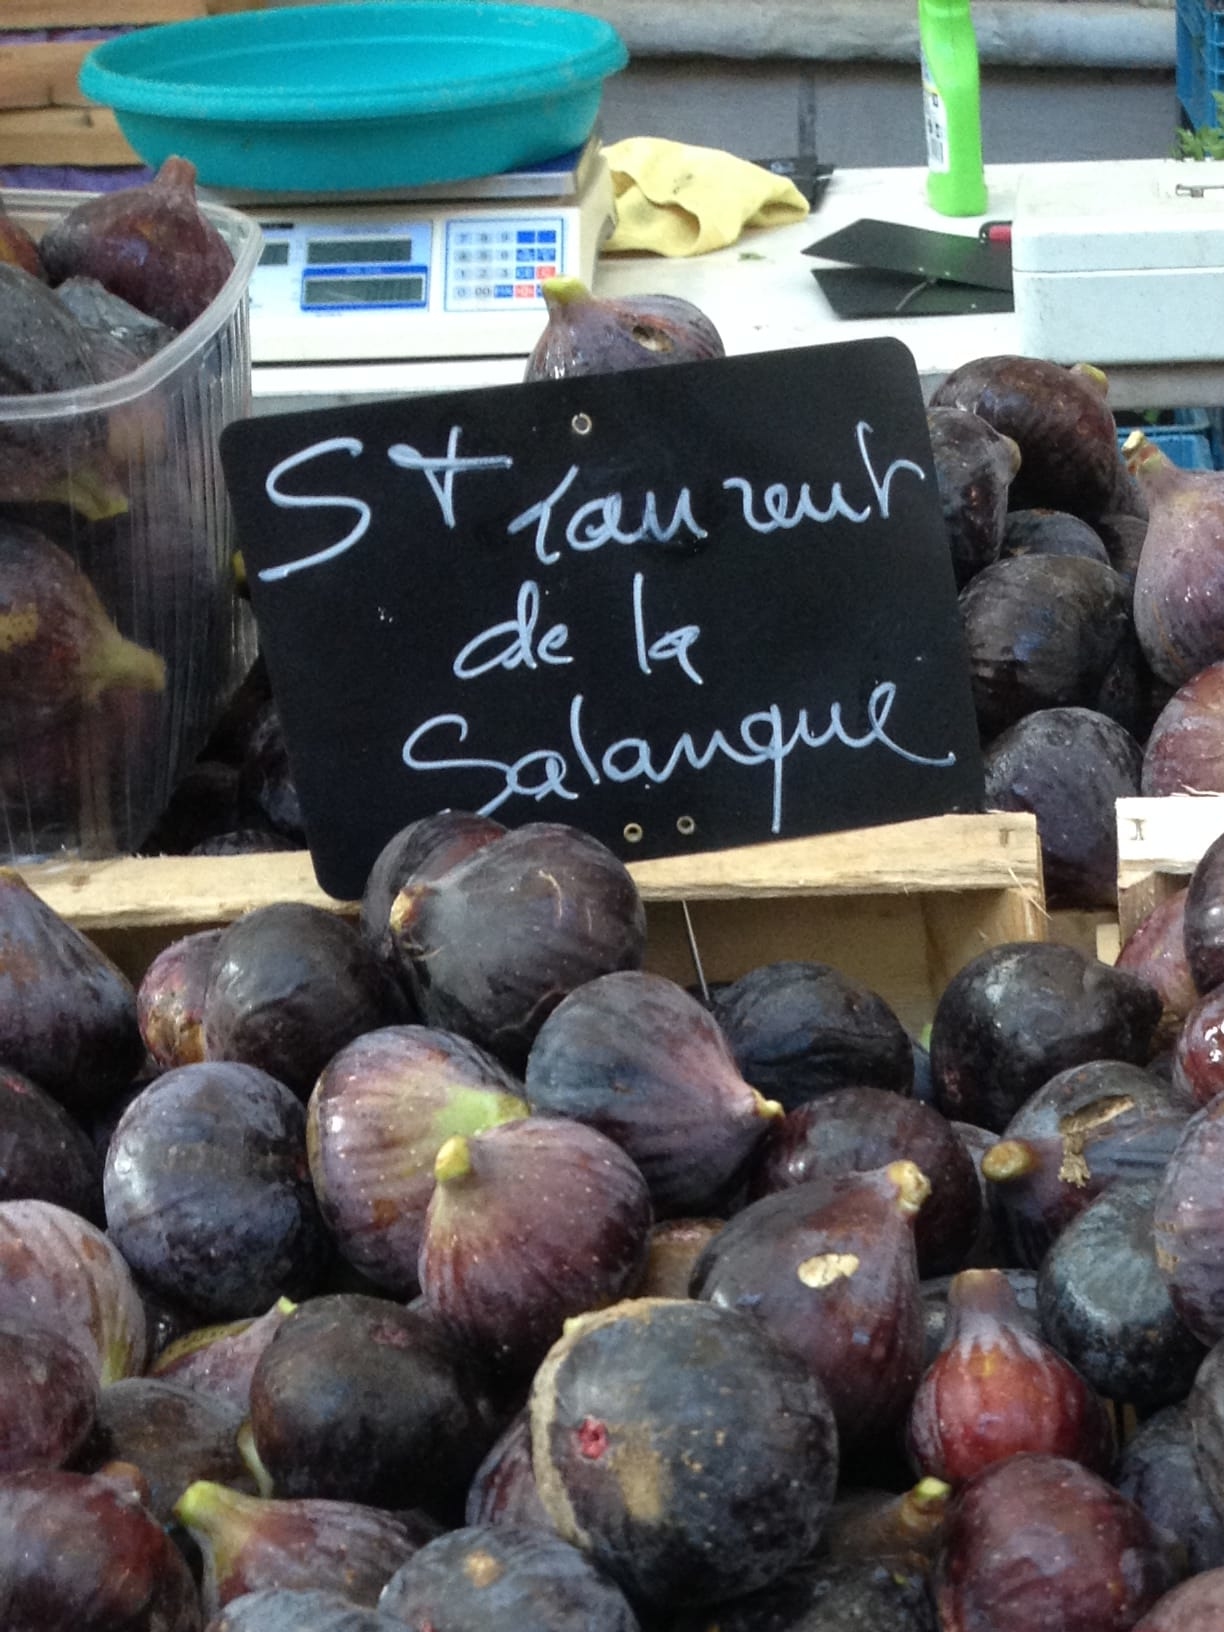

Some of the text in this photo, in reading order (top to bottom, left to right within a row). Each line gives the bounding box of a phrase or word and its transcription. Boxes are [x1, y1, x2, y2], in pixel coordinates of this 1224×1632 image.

[453, 571, 704, 685] de la
[402, 681, 957, 834] Salanque
